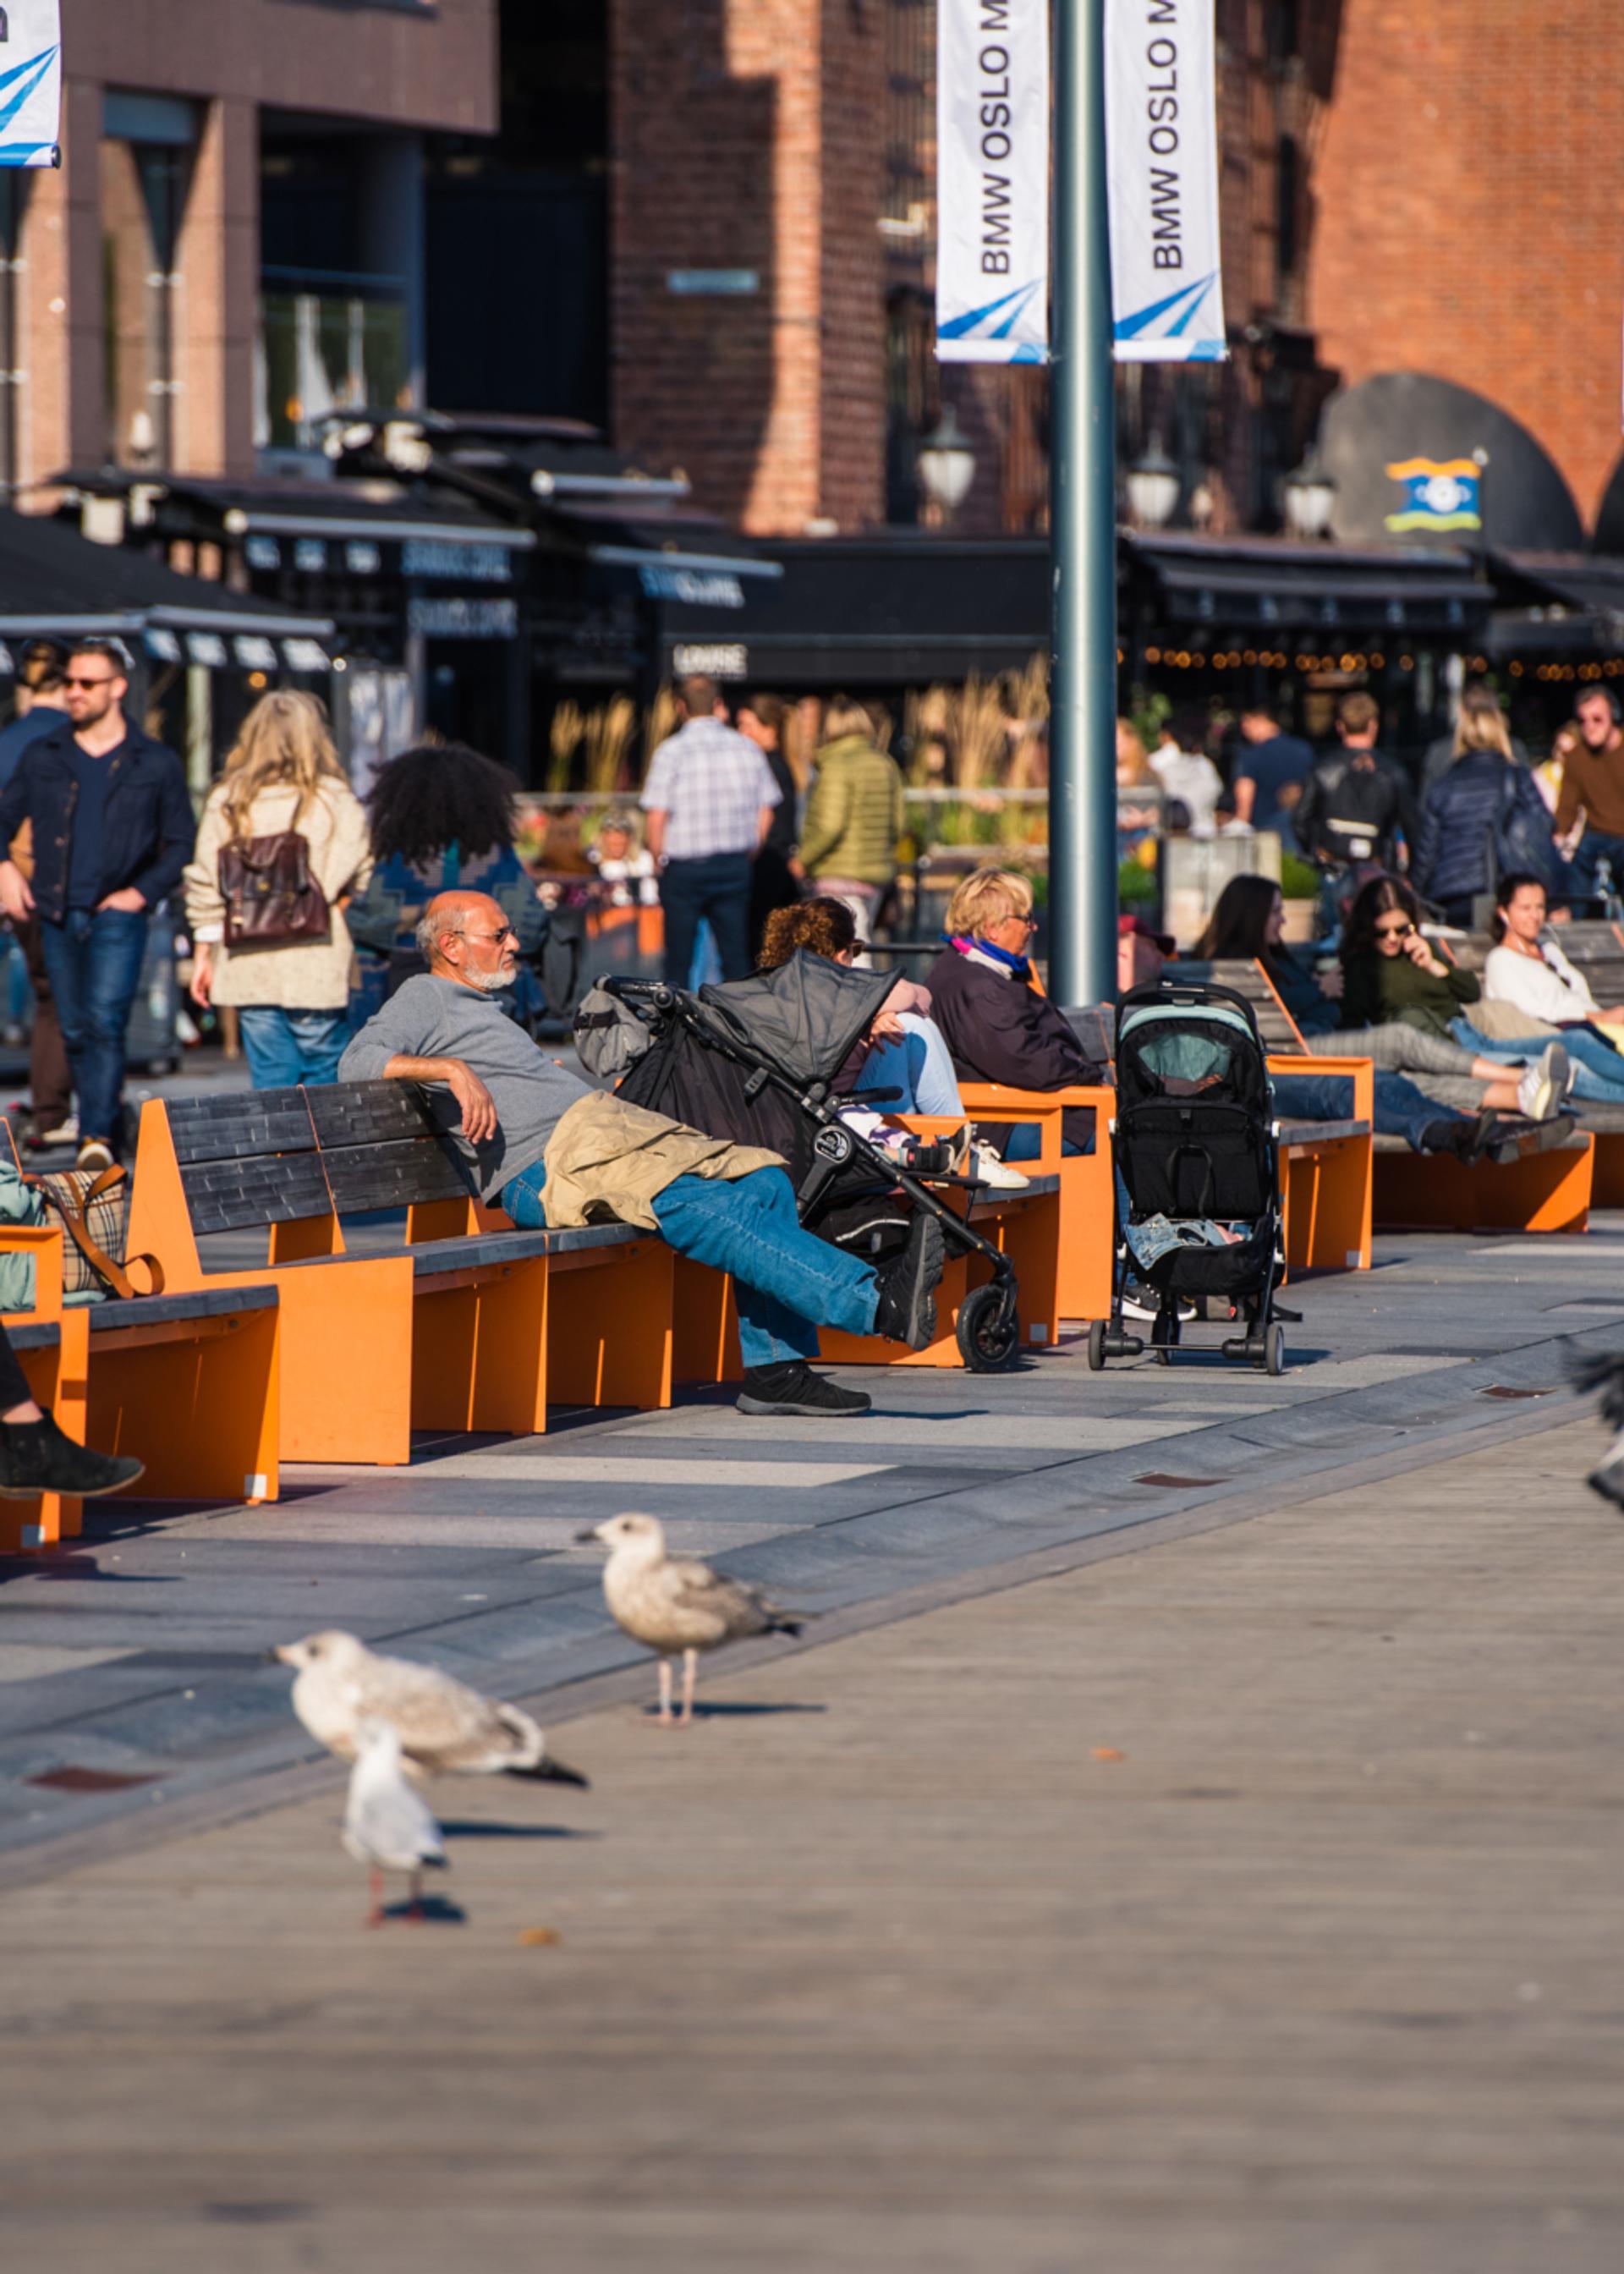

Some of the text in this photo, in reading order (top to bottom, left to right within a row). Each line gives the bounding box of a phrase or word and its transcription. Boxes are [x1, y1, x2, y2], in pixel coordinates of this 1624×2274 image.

[979, 0, 1012, 274] BMW OSLO M
[1147, 38, 1178, 155] OSLO
[1150, 168, 1182, 270] BMW
